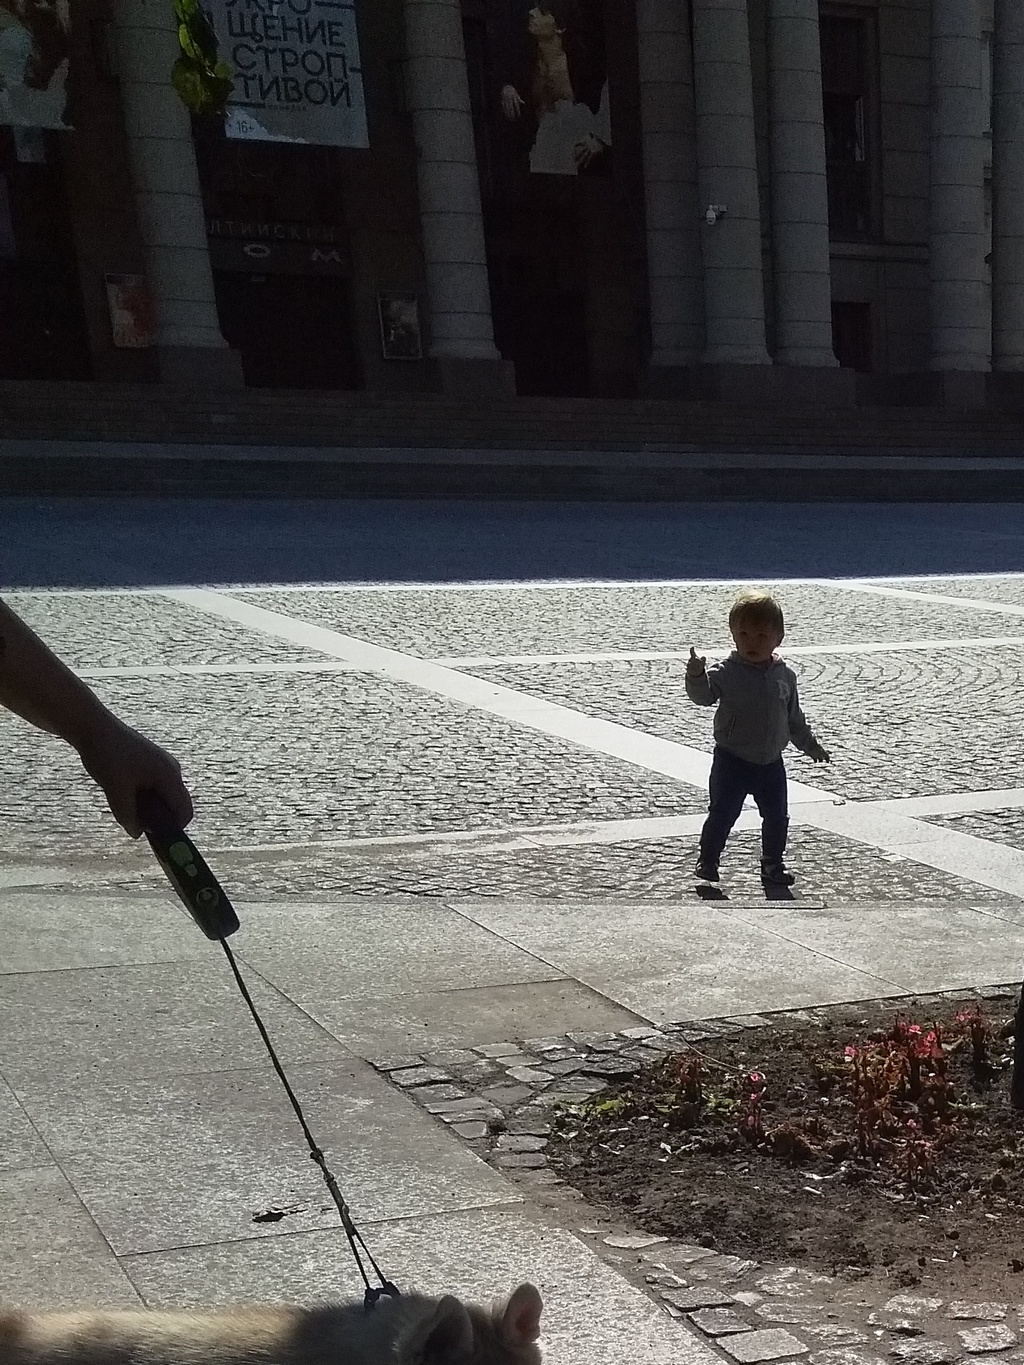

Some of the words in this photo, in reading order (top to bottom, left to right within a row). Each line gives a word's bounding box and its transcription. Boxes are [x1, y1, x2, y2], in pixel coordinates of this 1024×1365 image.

[227, 11, 346, 48] ЩЕНИЕ
[234, 72, 351, 108] ТИВОЙ
[237, 120, 254, 133] 16+
